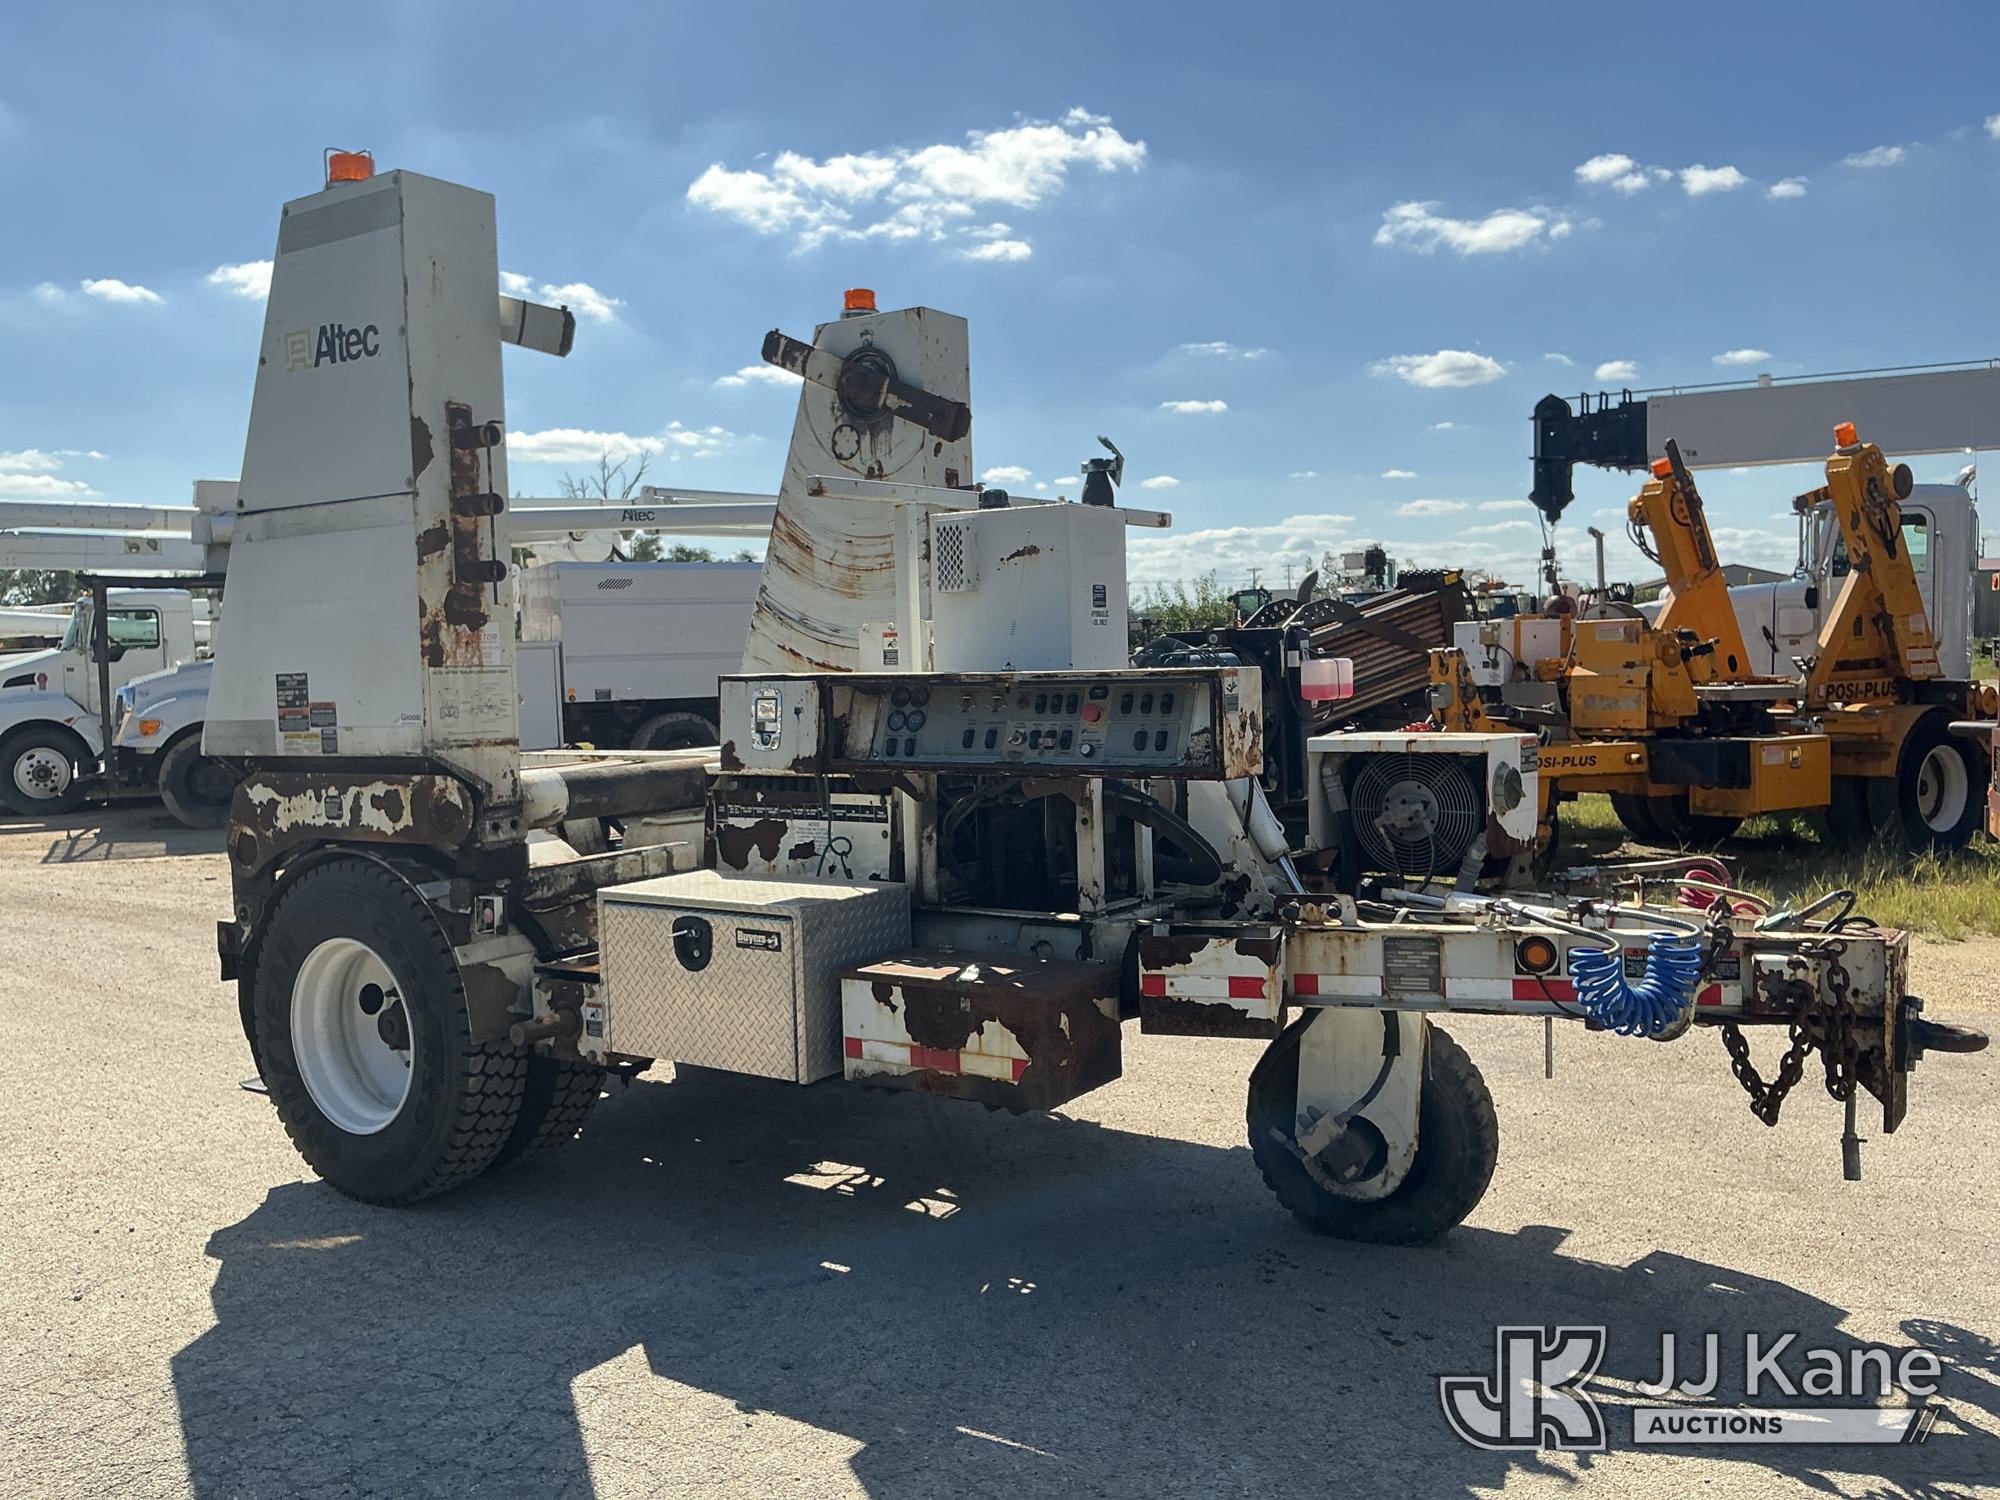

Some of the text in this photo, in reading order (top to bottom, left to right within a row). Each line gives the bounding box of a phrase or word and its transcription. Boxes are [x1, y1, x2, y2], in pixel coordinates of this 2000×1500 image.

[314, 323, 380, 368] Altec
[622, 509, 656, 522] Altec
[1826, 680, 1899, 700] POSI-PLUS
[1537, 755, 1597, 769] OSI-PLUS
[736, 930, 767, 945] Buyers
